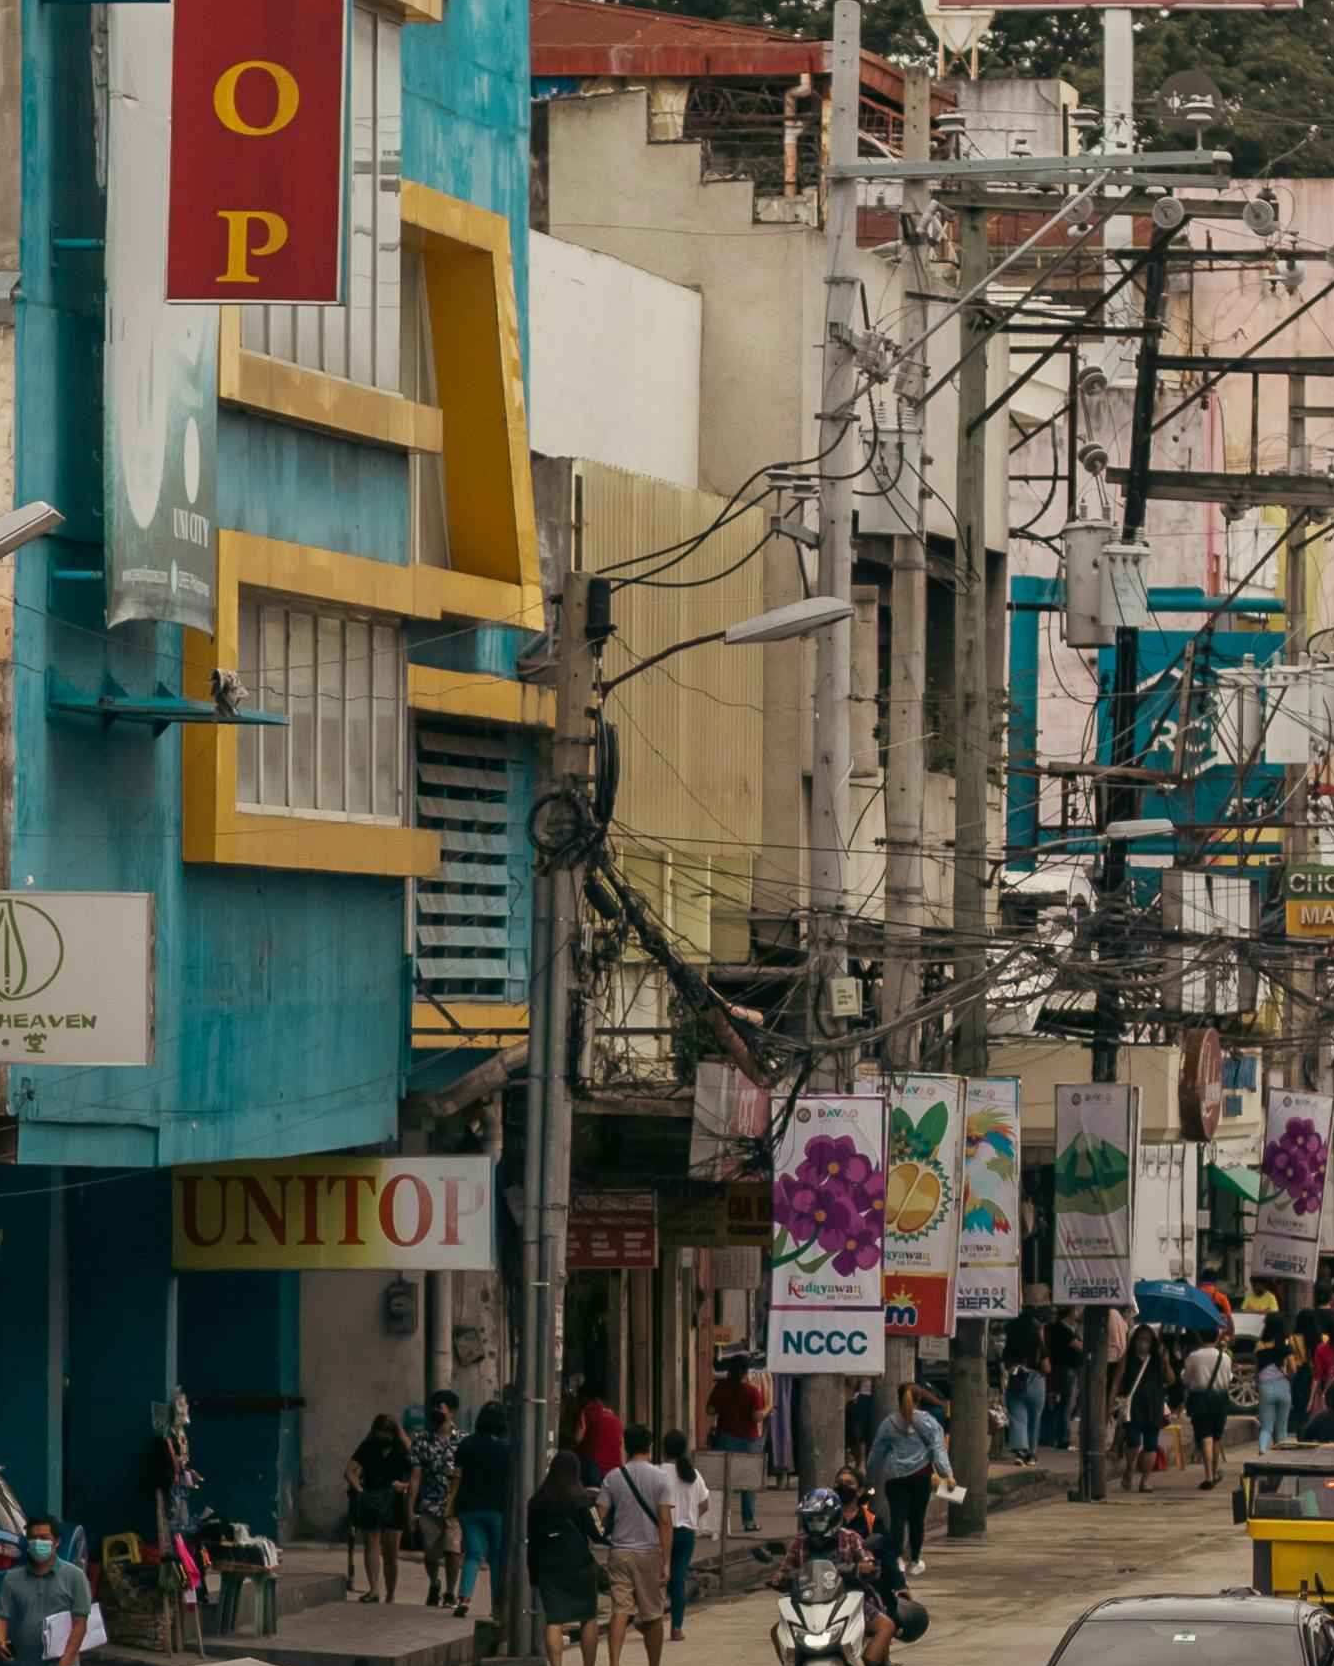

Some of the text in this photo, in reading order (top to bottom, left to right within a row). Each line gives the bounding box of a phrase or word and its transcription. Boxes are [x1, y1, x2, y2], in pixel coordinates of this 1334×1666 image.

[181, 1173, 485, 1247] UNITOP
[788, 1279, 862, 1299] Kadayawan
[783, 1330, 867, 1355] NCCC
